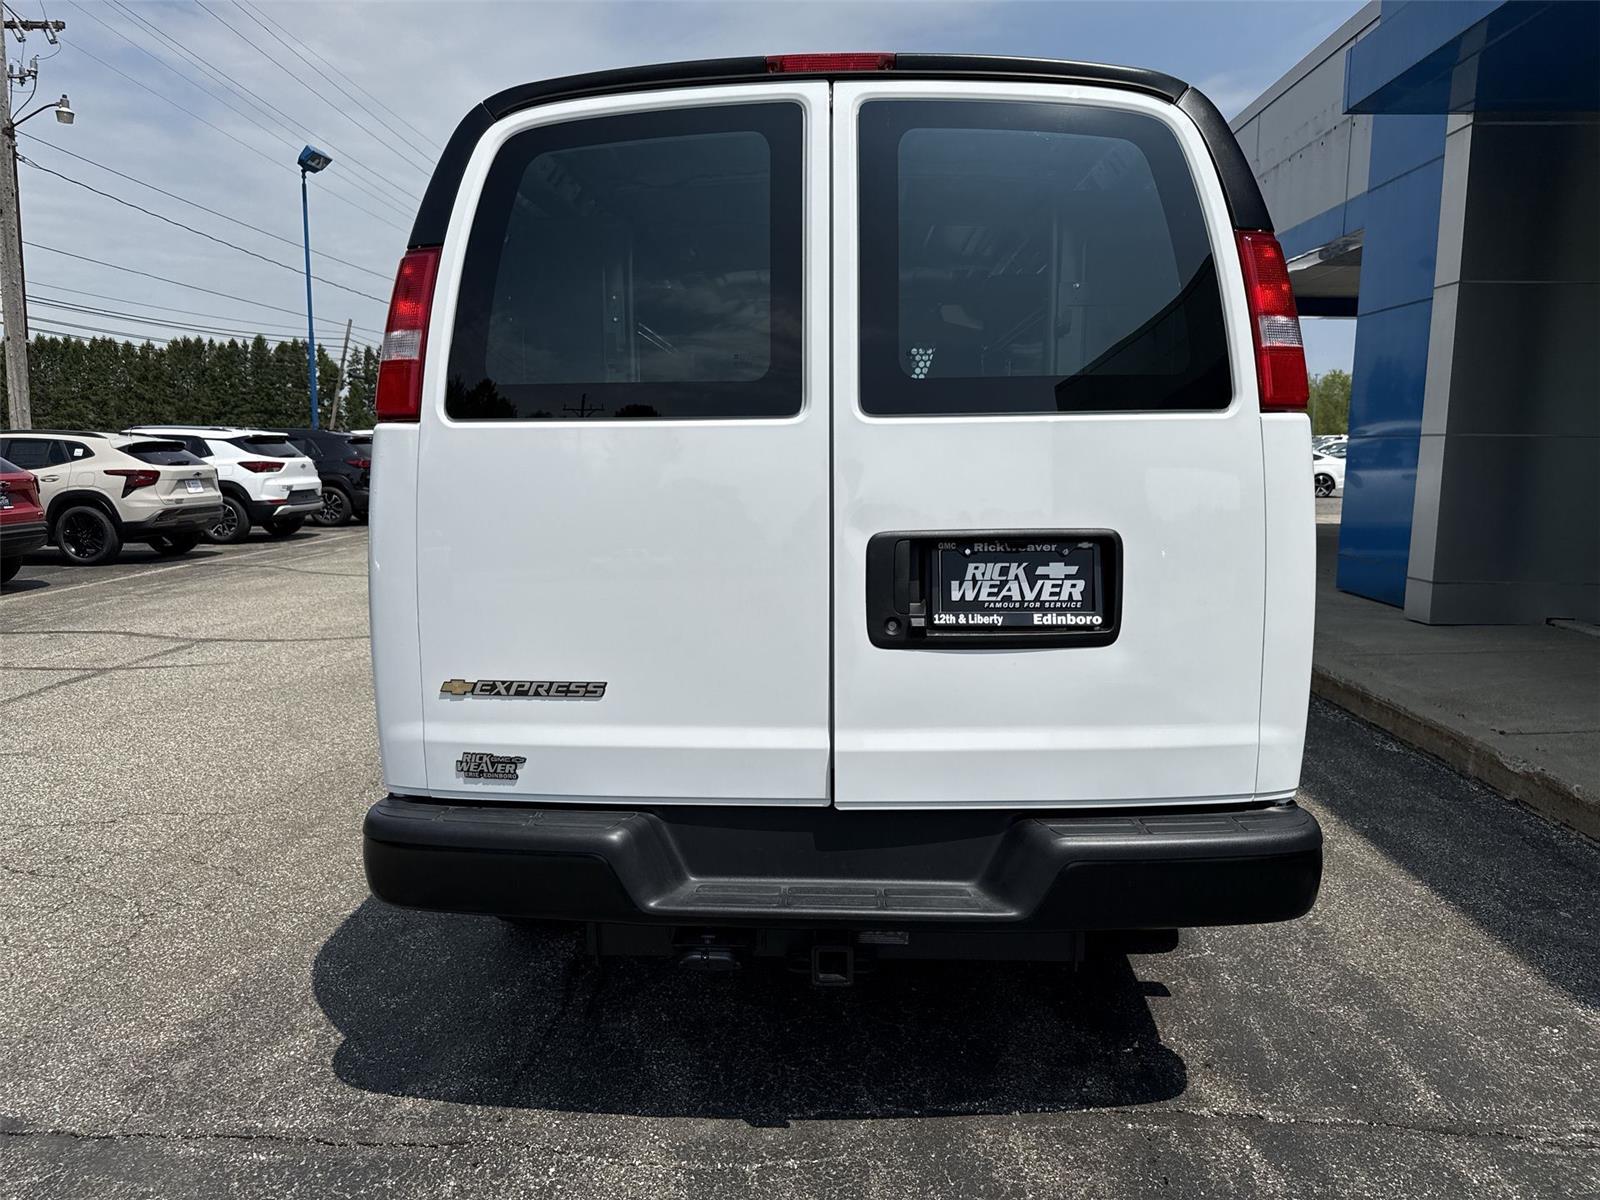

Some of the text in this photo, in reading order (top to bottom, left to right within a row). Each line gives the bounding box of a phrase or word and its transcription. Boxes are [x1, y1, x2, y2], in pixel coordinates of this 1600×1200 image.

[964, 562, 1030, 581] RICK
[950, 580, 1086, 602] WEAVER
[933, 614, 1003, 626] 12th & Liberty
[1033, 613, 1102, 625] Edinboro
[473, 681, 607, 697] EXPRESS
[462, 753, 492, 763] RICK
[456, 761, 516, 774] WEAVER
[483, 772, 518, 780] EDINBORO
